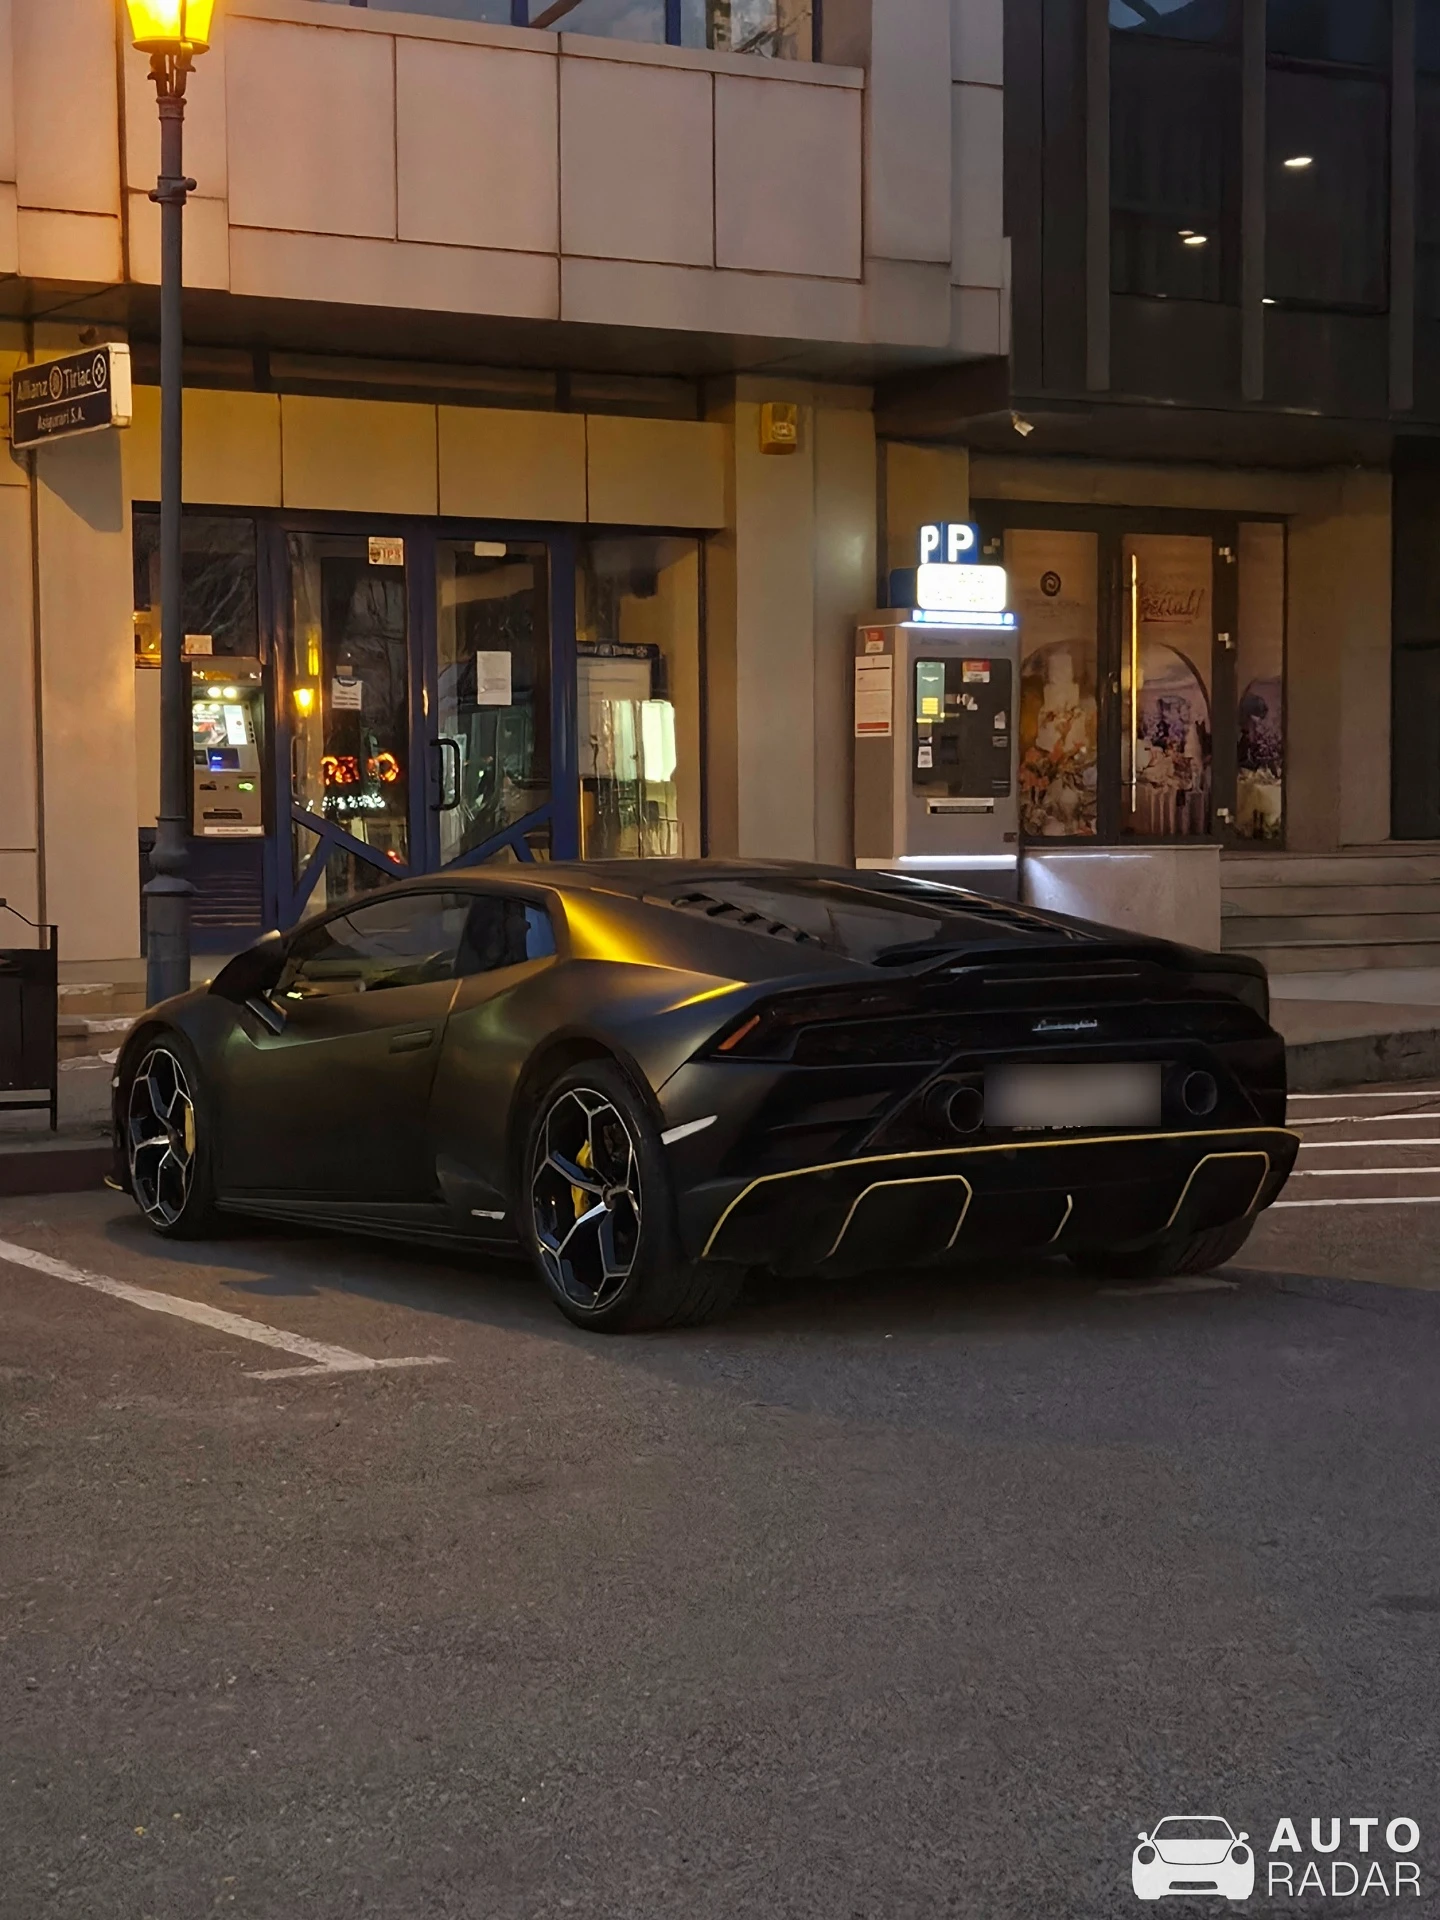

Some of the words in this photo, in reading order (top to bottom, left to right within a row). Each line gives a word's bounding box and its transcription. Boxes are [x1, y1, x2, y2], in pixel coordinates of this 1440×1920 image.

[18, 380, 48, 401] Allianz
[920, 525, 939, 564] P
[948, 523, 974, 563] P
